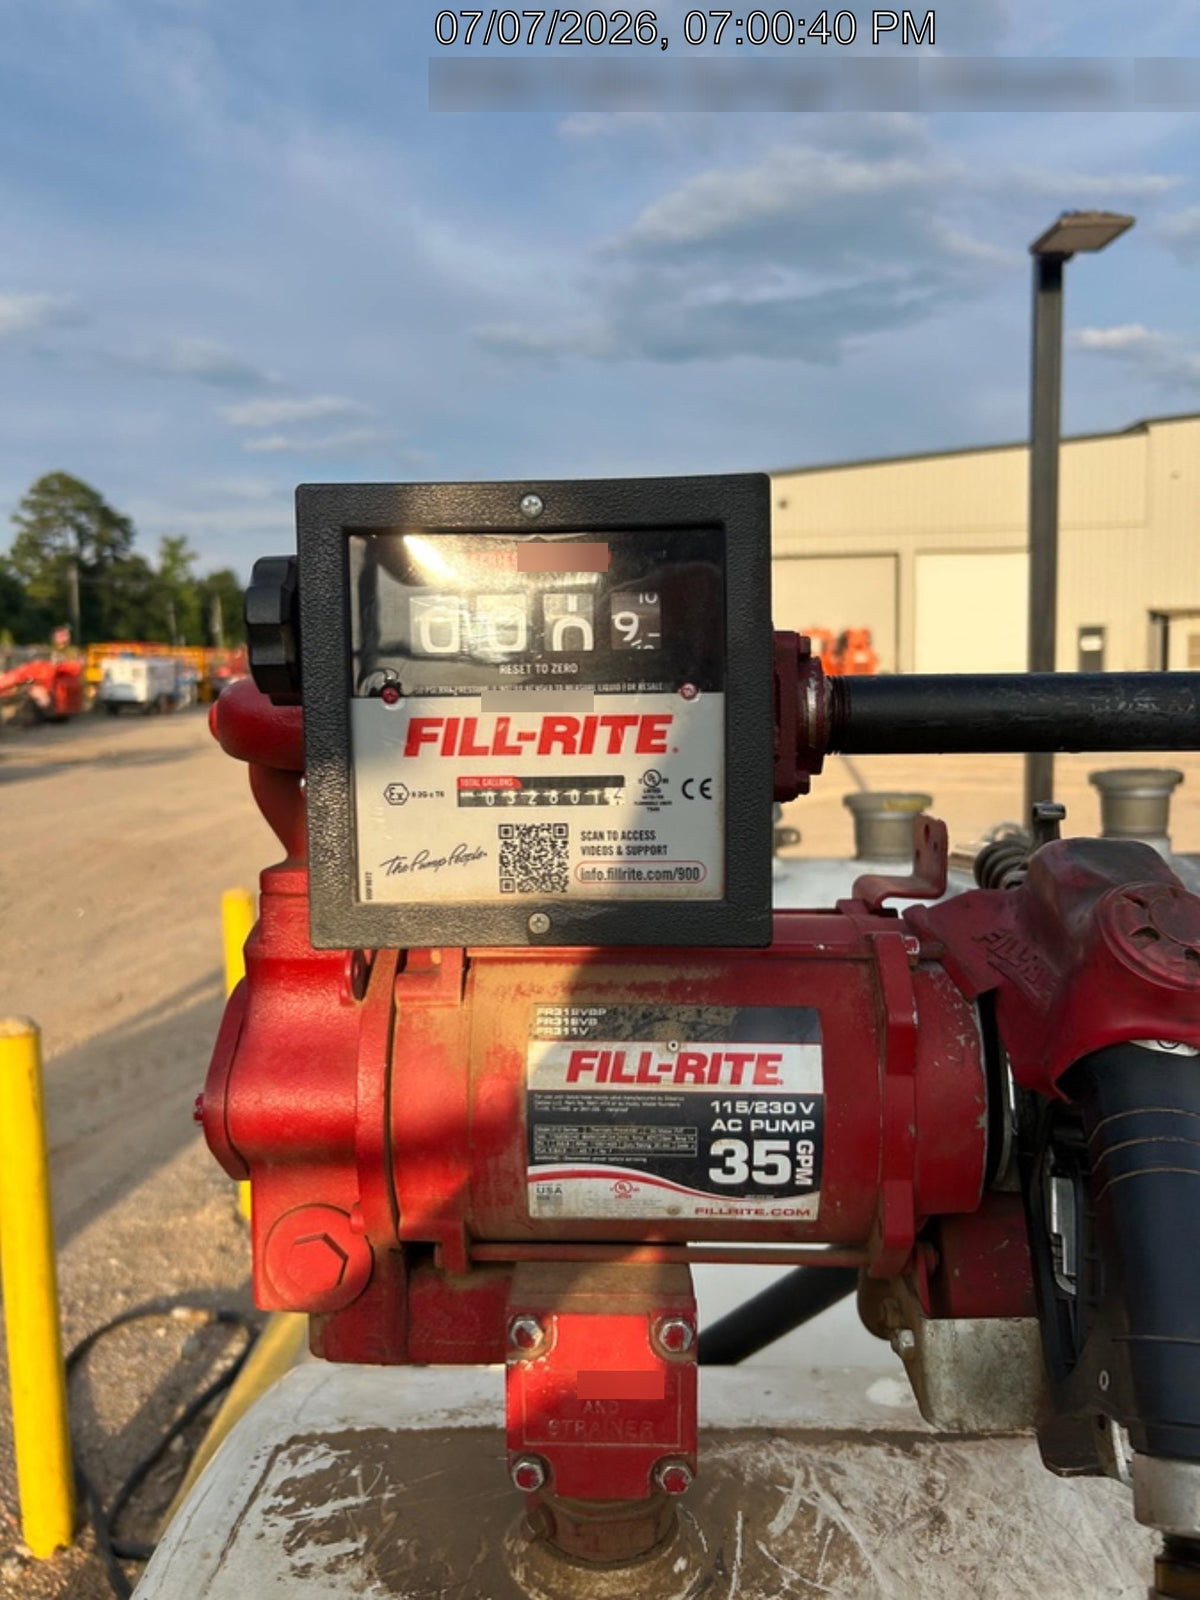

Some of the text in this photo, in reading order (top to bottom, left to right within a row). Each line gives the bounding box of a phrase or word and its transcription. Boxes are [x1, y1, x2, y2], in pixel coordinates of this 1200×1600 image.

[499, 662, 579, 676] RESET TO ZERO
[402, 714, 674, 758] FILL-RITE
[681, 778, 712, 800] CE
[580, 829, 656, 842] SCAN TO ACCESS
[580, 845, 668, 856] VIDEOS & SUPPORT
[380, 855, 409, 876] The
[409, 849, 447, 873] Pump
[580, 866, 700, 882] info.fillrite.com/900
[565, 1050, 783, 1086] FILL-RITE
[710, 1101, 816, 1115] 115/230 V
[710, 1119, 816, 1134] AC PUMP
[708, 1139, 792, 1186] 35
[795, 1140, 815, 1186] GPM
[536, 1186, 563, 1195] USA
[694, 1207, 811, 1217] FILLRITE.COM
